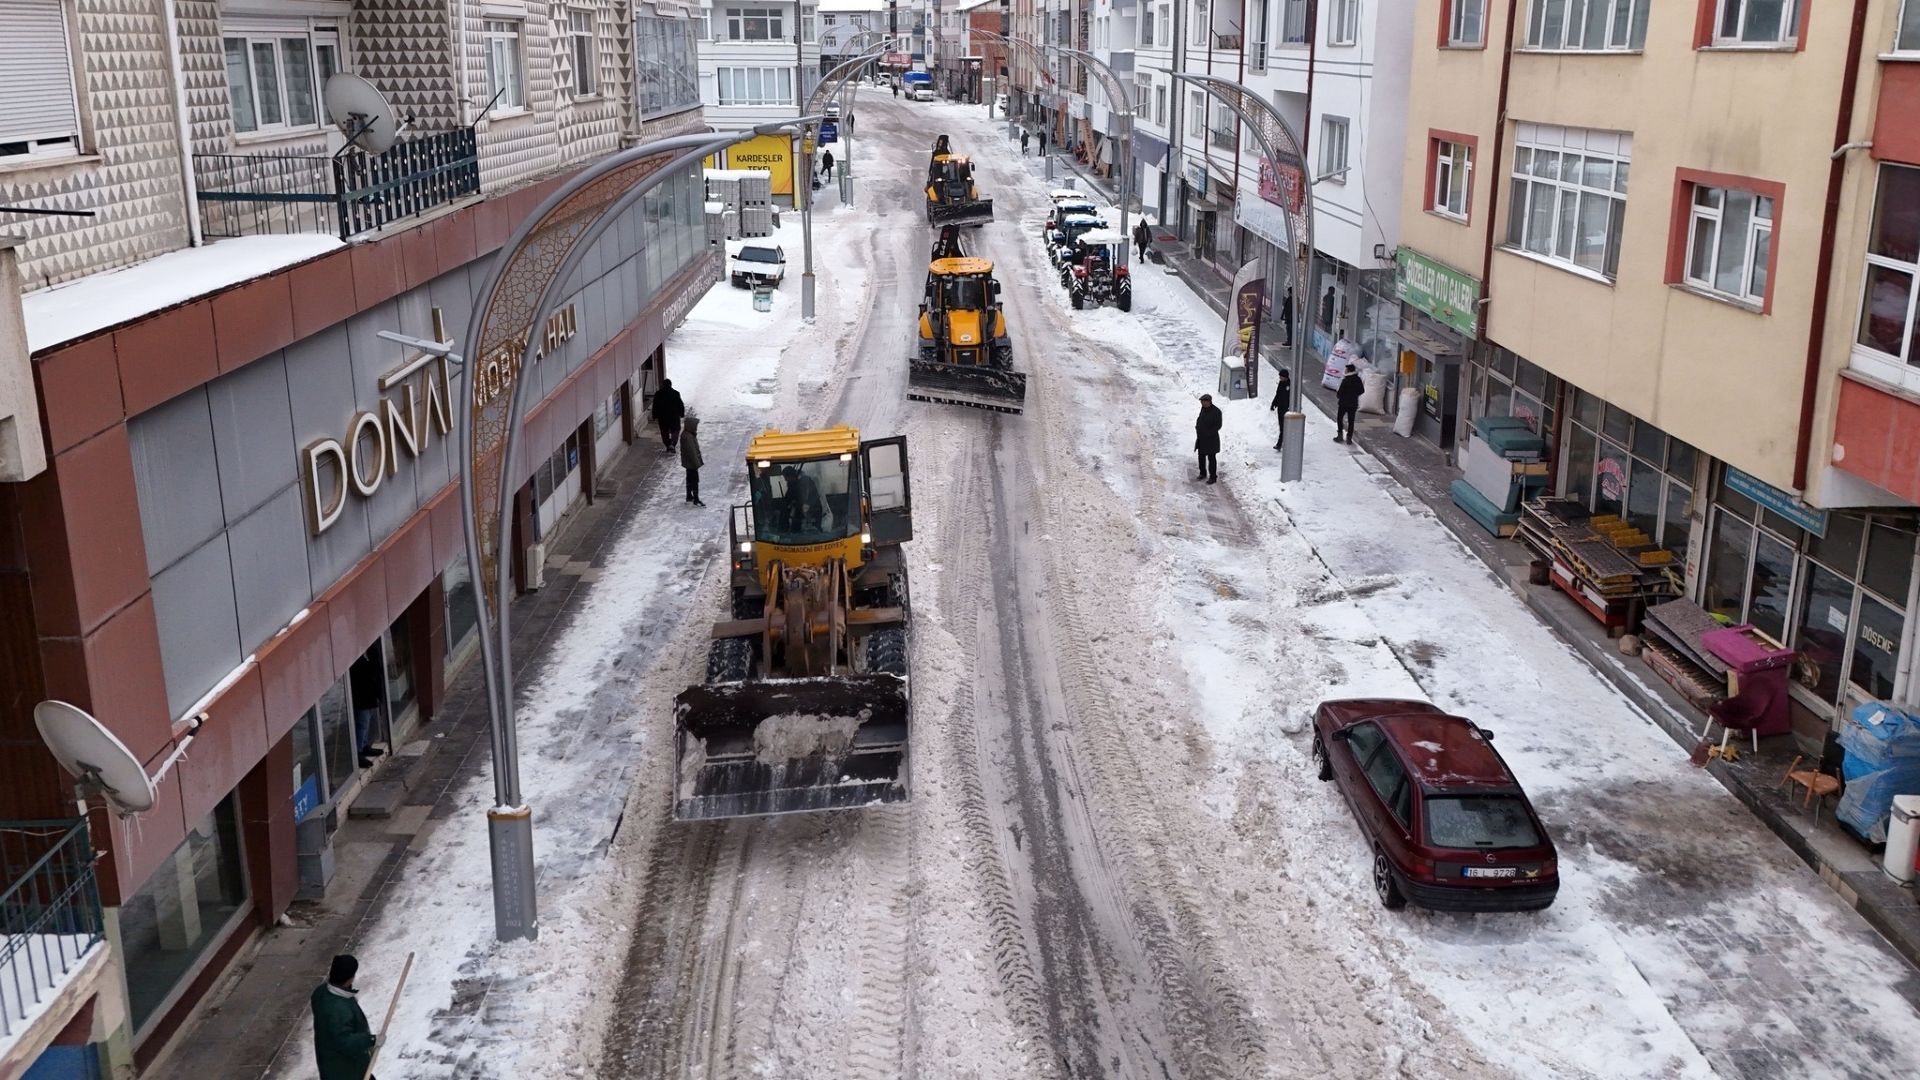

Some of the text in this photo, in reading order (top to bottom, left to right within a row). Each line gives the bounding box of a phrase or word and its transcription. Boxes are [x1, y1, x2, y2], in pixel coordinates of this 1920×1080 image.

[736, 153, 783, 164] KARDEŞLER
[1406, 254, 1473, 315] GÜZELLER OTO GALERİ
[545, 303, 577, 355] HALI
[1469, 868, 1478, 877] 16
[1493, 868, 1516, 877] 9728
